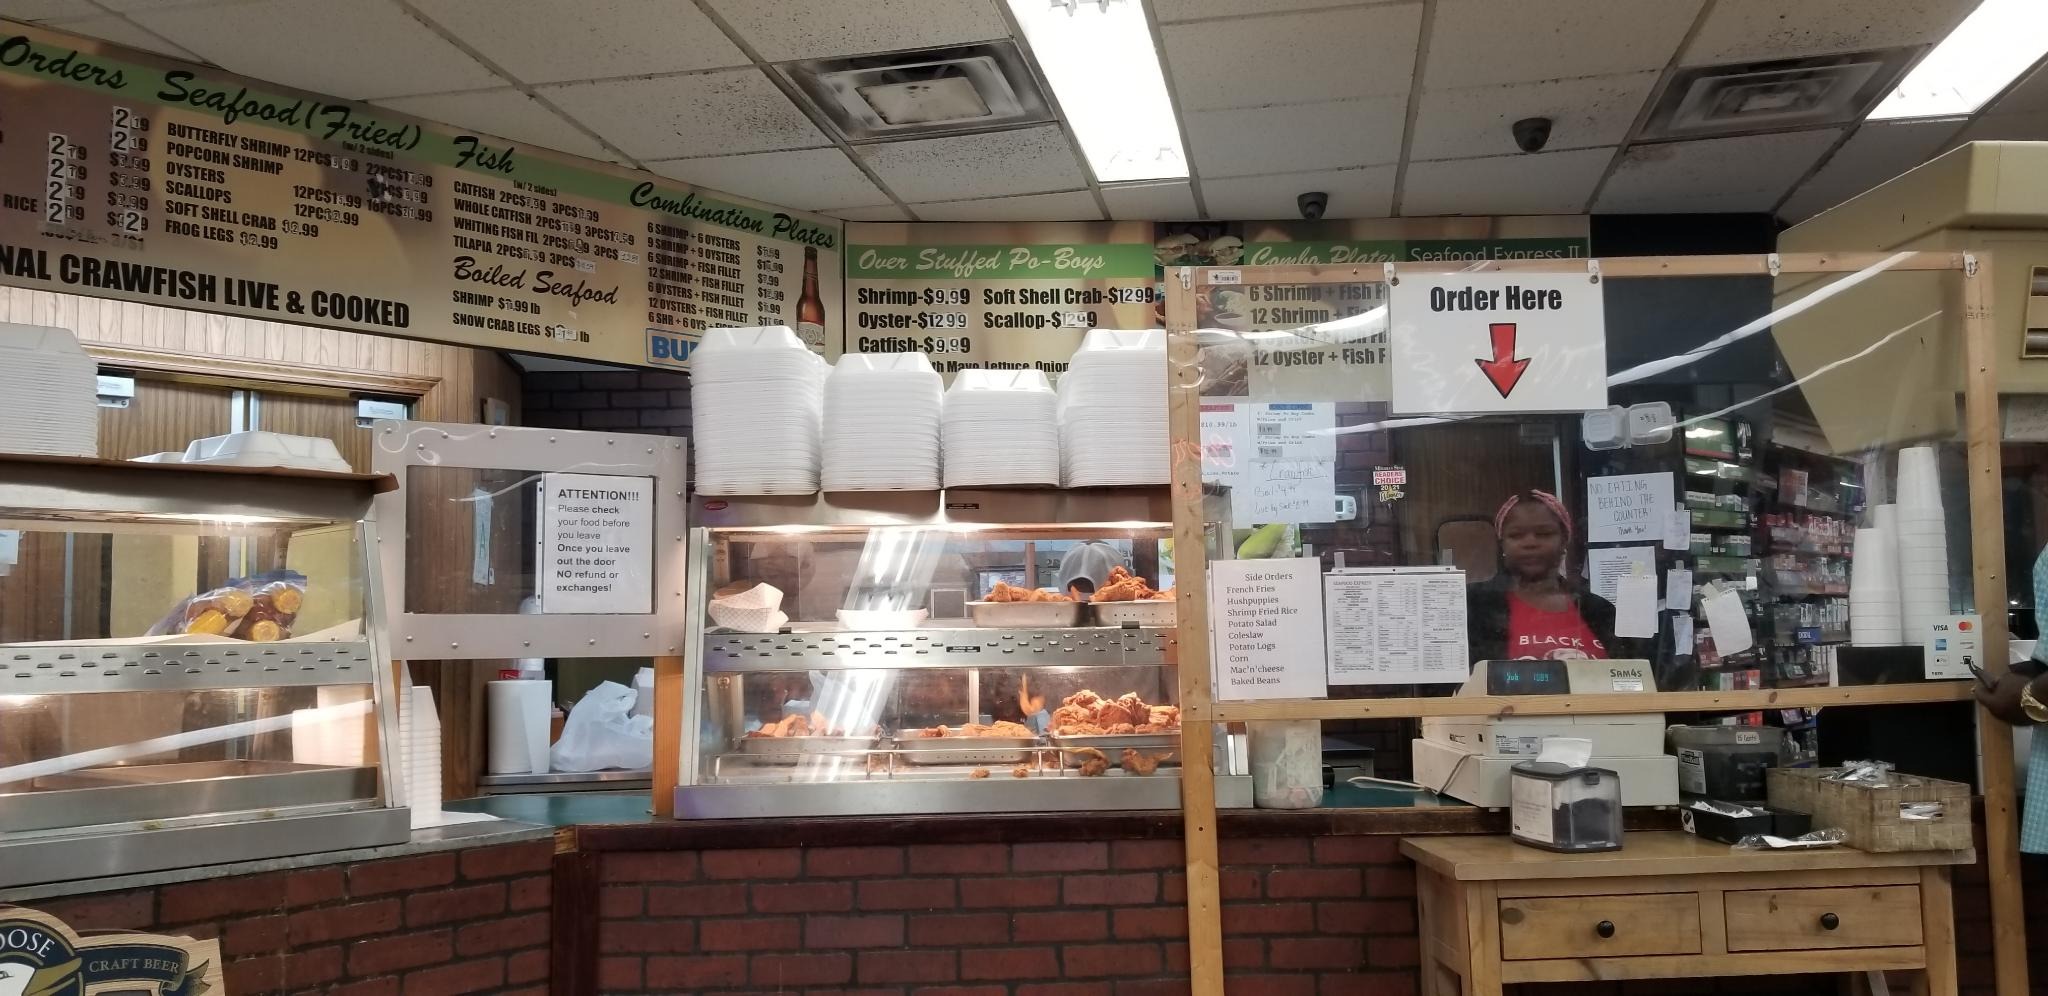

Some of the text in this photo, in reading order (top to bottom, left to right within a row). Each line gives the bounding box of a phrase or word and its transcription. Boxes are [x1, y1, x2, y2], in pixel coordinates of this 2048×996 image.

[0, 36, 127, 90] Orders
[157, 71, 302, 127] Seafood
[168, 122, 291, 158] BUTTERFLY SHRIMP
[167, 142, 230, 166] POPCORN
[233, 154, 283, 175] SHRIMP
[453, 135, 515, 174] Fish
[167, 162, 225, 184] OYSTERS
[166, 180, 232, 204] SCALLOPS
[454, 180, 495, 200] CATFISH
[3, 194, 38, 213] RICE
[454, 198, 490, 217] WHOLE
[491, 206, 532, 225] CATFISH
[165, 200, 199, 218] SOFT
[202, 206, 239, 225] SHELL
[242, 213, 276, 230] CRAB
[629, 181, 764, 233] Combination
[771, 212, 835, 249] Plates
[165, 219, 200, 238] FROG
[203, 225, 234, 243] LEGS
[454, 216, 499, 236] WHITING
[501, 225, 524, 241] FISH
[525, 229, 539, 244] FIL
[647, 222, 740, 251] 6 SHRIMP 6 OYSTERS
[453, 235, 492, 254] TILAPIA
[647, 237, 653, 248] 9
[655, 238, 688, 255] SHRIMP
[698, 247, 703, 258] 9
[705, 248, 740, 265] OYSTERS
[1411, 246, 1486, 261] Seafood
[647, 252, 653, 263] 6
[655, 253, 688, 270] SHRIMP
[698, 262, 716, 275] FISH
[718, 264, 741, 279] FILLET
[859, 247, 1106, 278] Over Stuffed Po-Boys
[453, 256, 527, 290] Boiled
[532, 270, 619, 307] Seafood
[648, 266, 744, 294] 12 SHRIMP FISH FILLET
[59, 253, 217, 302] CRAWFISH
[224, 277, 279, 312] LIVE
[286, 290, 306, 315] &
[311, 290, 410, 329] COOKED
[647, 282, 744, 309] 6 OYSTERS FISH FILLET
[983, 288, 1016, 305] Soft
[1019, 288, 1060, 305] Shell
[1250, 284, 1371, 302] 6 Shrimp Fish
[1430, 285, 1562, 312] Order Here
[452, 290, 541, 315] SHRIMP lb
[648, 297, 748, 324] 12 OYSTERS FISH FILLET
[648, 312, 707, 331] 6 SHR 6 OYS
[1251, 307, 1329, 325] 12 Shrimp
[452, 312, 589, 343] SNOW CRAB LEGS lb
[1254, 348, 1374, 367] 12 Oyster Fish
[558, 488, 639, 502] ATTENTION!!!
[558, 504, 620, 514] Please check
[558, 518, 630, 529] your food before
[557, 531, 601, 542] you leave
[557, 543, 630, 555] Once you leave
[557, 557, 615, 567] out the door
[557, 570, 619, 579] NO refund or
[1245, 573, 1293, 581] Side Orders
[556, 583, 612, 594] exchanges!
[1256, 585, 1275, 593] Fries
[1227, 597, 1279, 606] Hushpuppies
[1227, 608, 1257, 618] Shrimp
[1281, 607, 1298, 615] Rice
[1228, 618, 1277, 628] Potato Salad
[1228, 631, 1264, 640] Coleslaw
[1519, 635, 1585, 648] BLACK
[1229, 642, 1276, 651] Potato Logs
[1229, 655, 1249, 663] Corn
[1231, 677, 1281, 686] Baked Beans
[89, 958, 179, 974] CRAFT BEER
